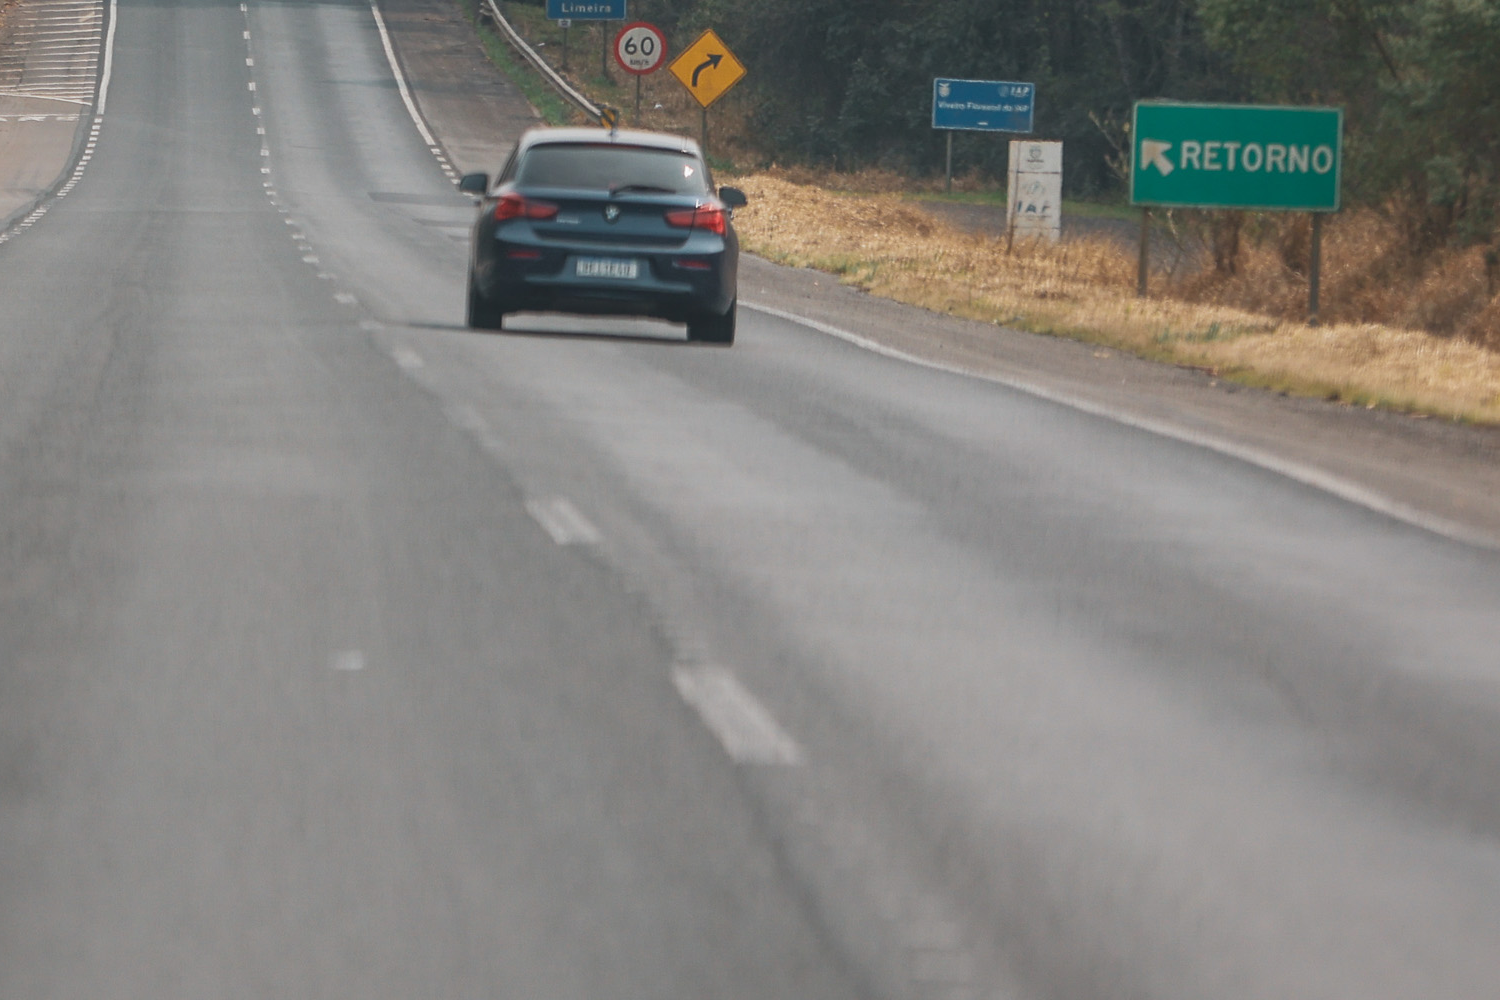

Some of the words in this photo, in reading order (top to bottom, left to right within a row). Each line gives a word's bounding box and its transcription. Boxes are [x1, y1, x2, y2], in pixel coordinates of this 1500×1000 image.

[562, 2, 612, 13] Limeira
[625, 36, 655, 57] 60
[1180, 140, 1334, 174] RETORNO
